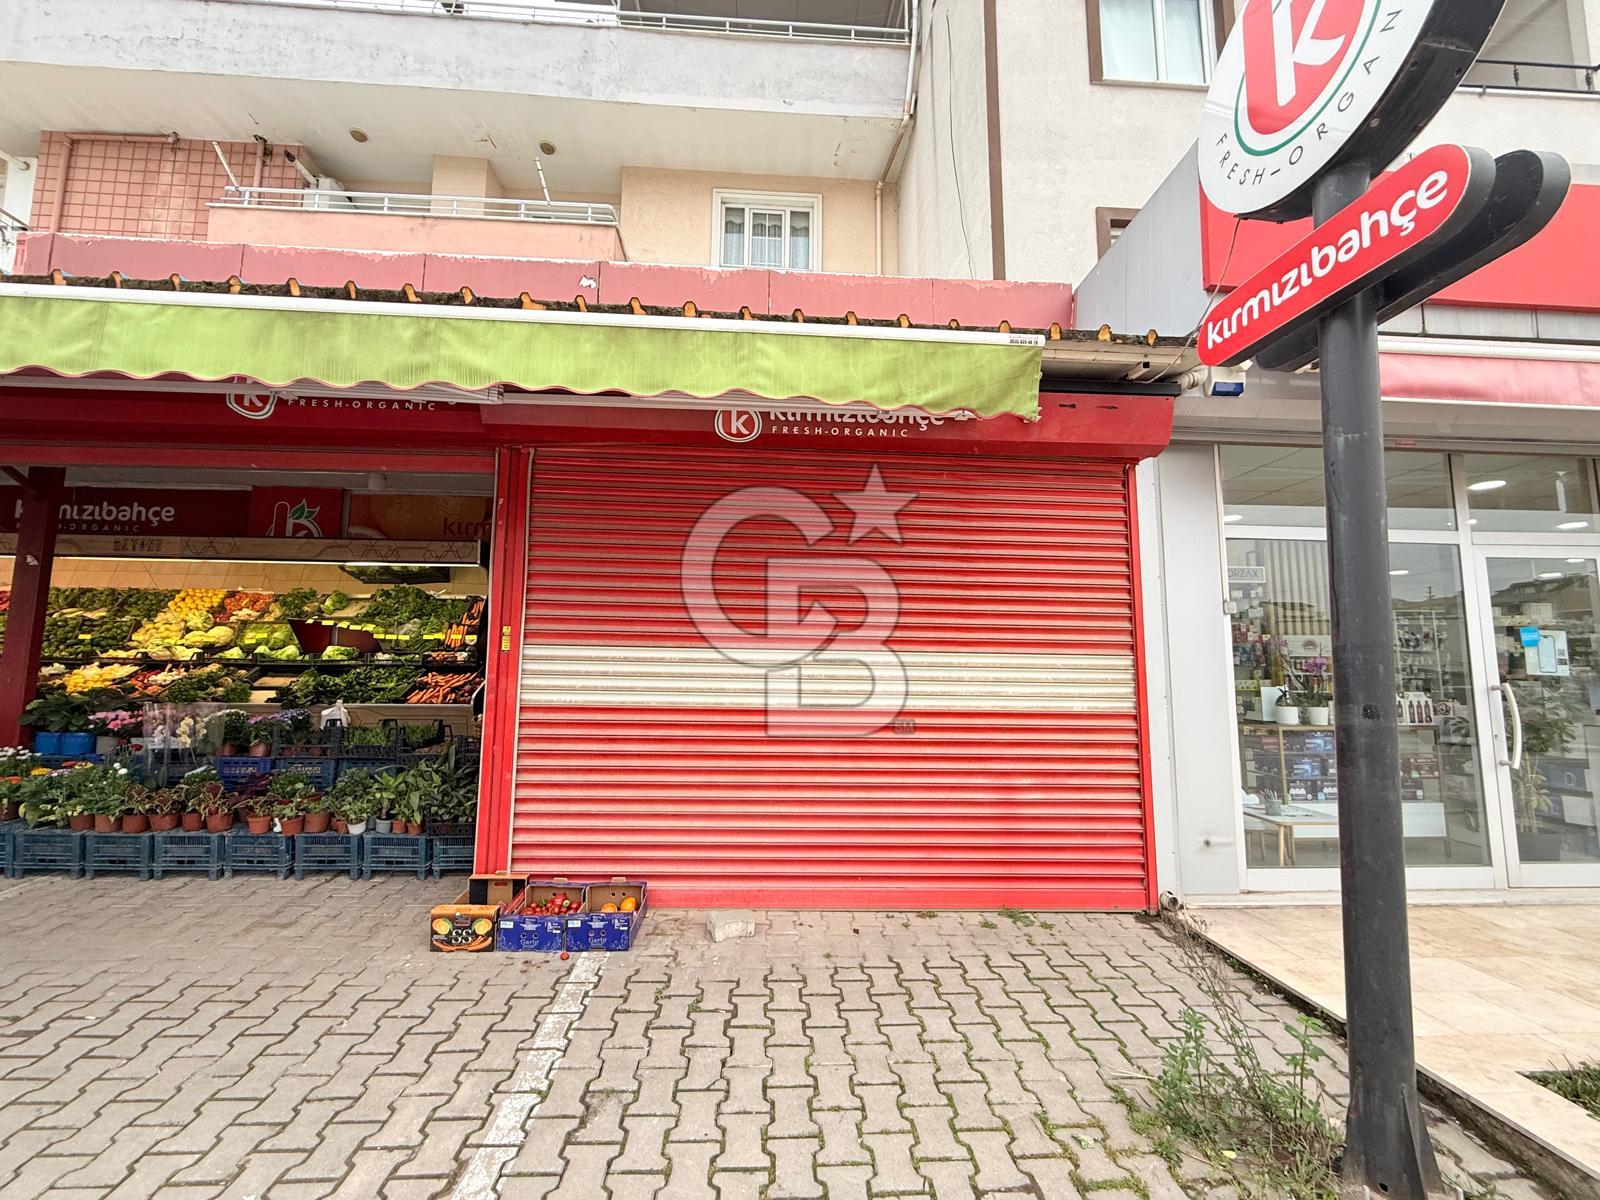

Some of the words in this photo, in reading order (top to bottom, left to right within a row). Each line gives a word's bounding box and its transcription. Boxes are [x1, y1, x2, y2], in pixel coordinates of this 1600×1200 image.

[1207, 170, 1448, 350] kırmızıbahçe
[287, 398, 436, 411] FRESH-ORGANIC
[771, 425, 909, 438] FRESH-ORGANIC
